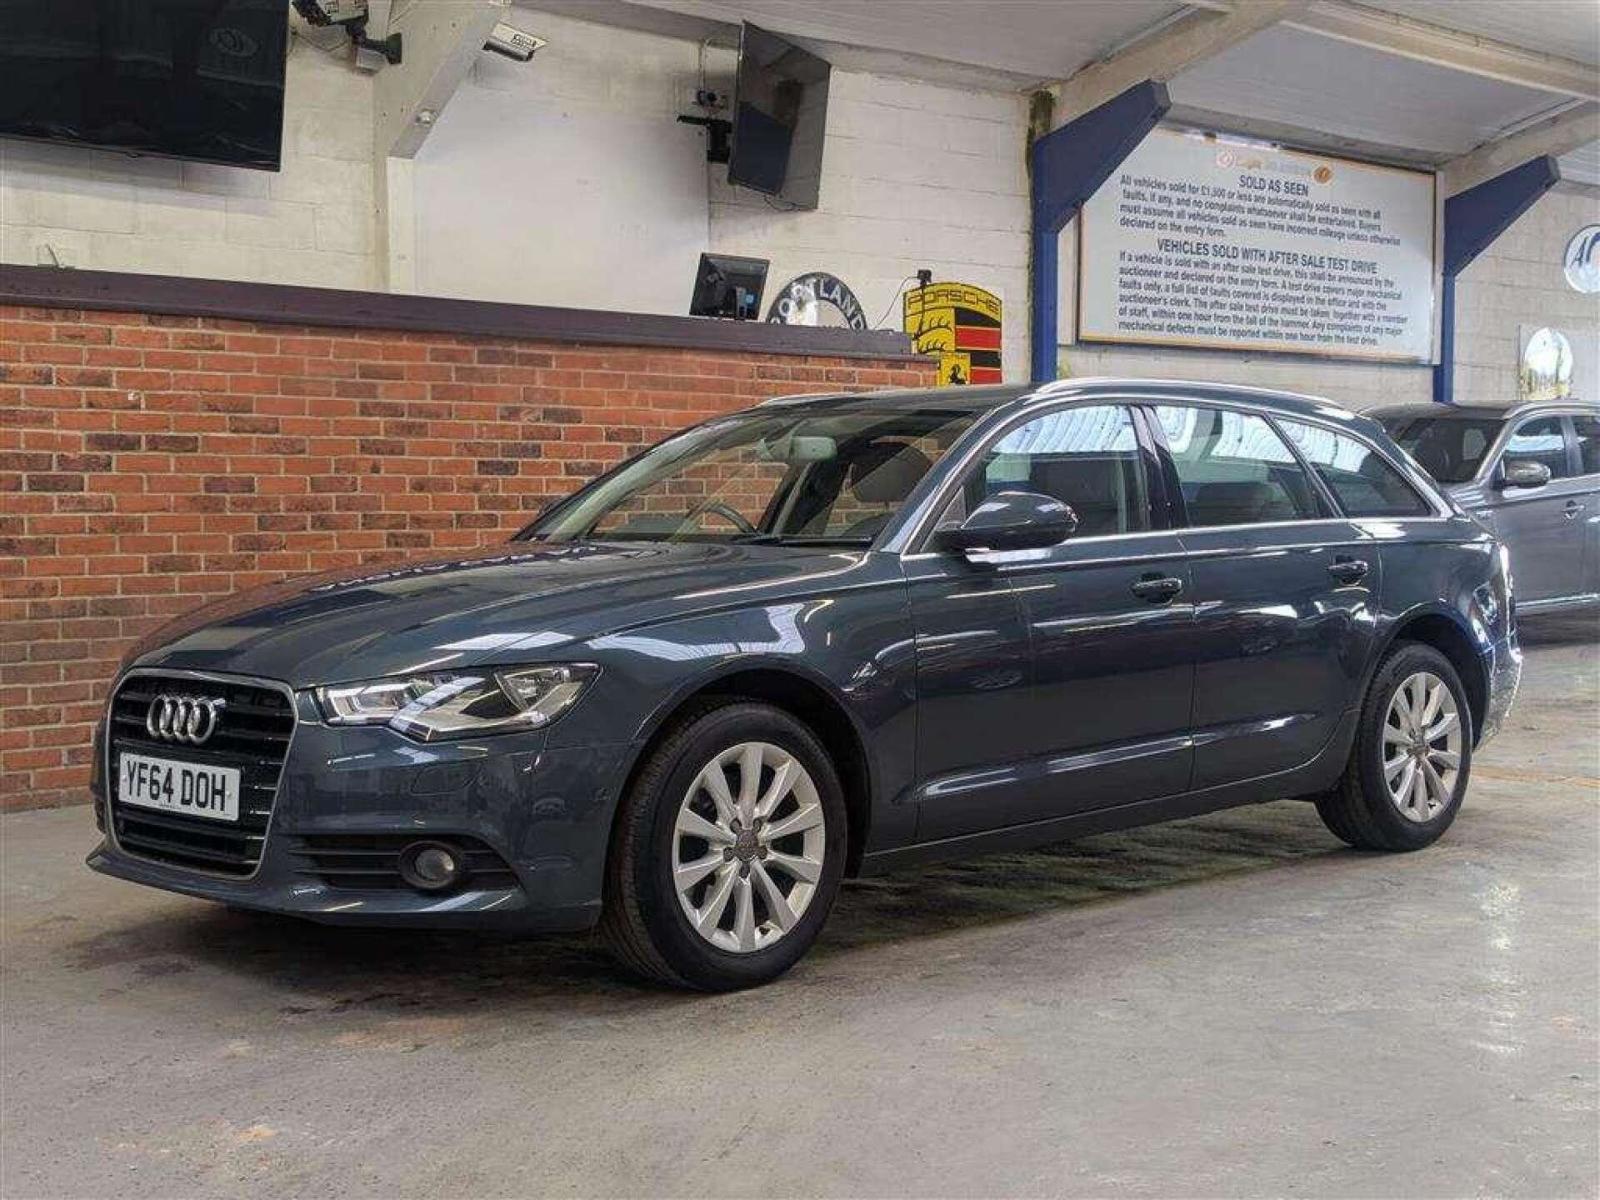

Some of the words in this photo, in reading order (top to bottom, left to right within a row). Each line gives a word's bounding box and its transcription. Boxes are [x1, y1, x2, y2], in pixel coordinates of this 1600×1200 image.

[1284, 181, 1308, 196] SEEN
[1158, 238, 1210, 256] VEHICLES
[1212, 244, 1239, 259] SOLD
[1241, 247, 1266, 262] WITH
[1268, 250, 1299, 264] AFTER
[1301, 254, 1325, 268] SALE
[1327, 257, 1348, 271] TEST
[1352, 260, 1377, 274] DRIVE
[908, 289, 999, 315] PORSCHE
[127, 760, 174, 803] YF64
[181, 769, 226, 812] DOH
